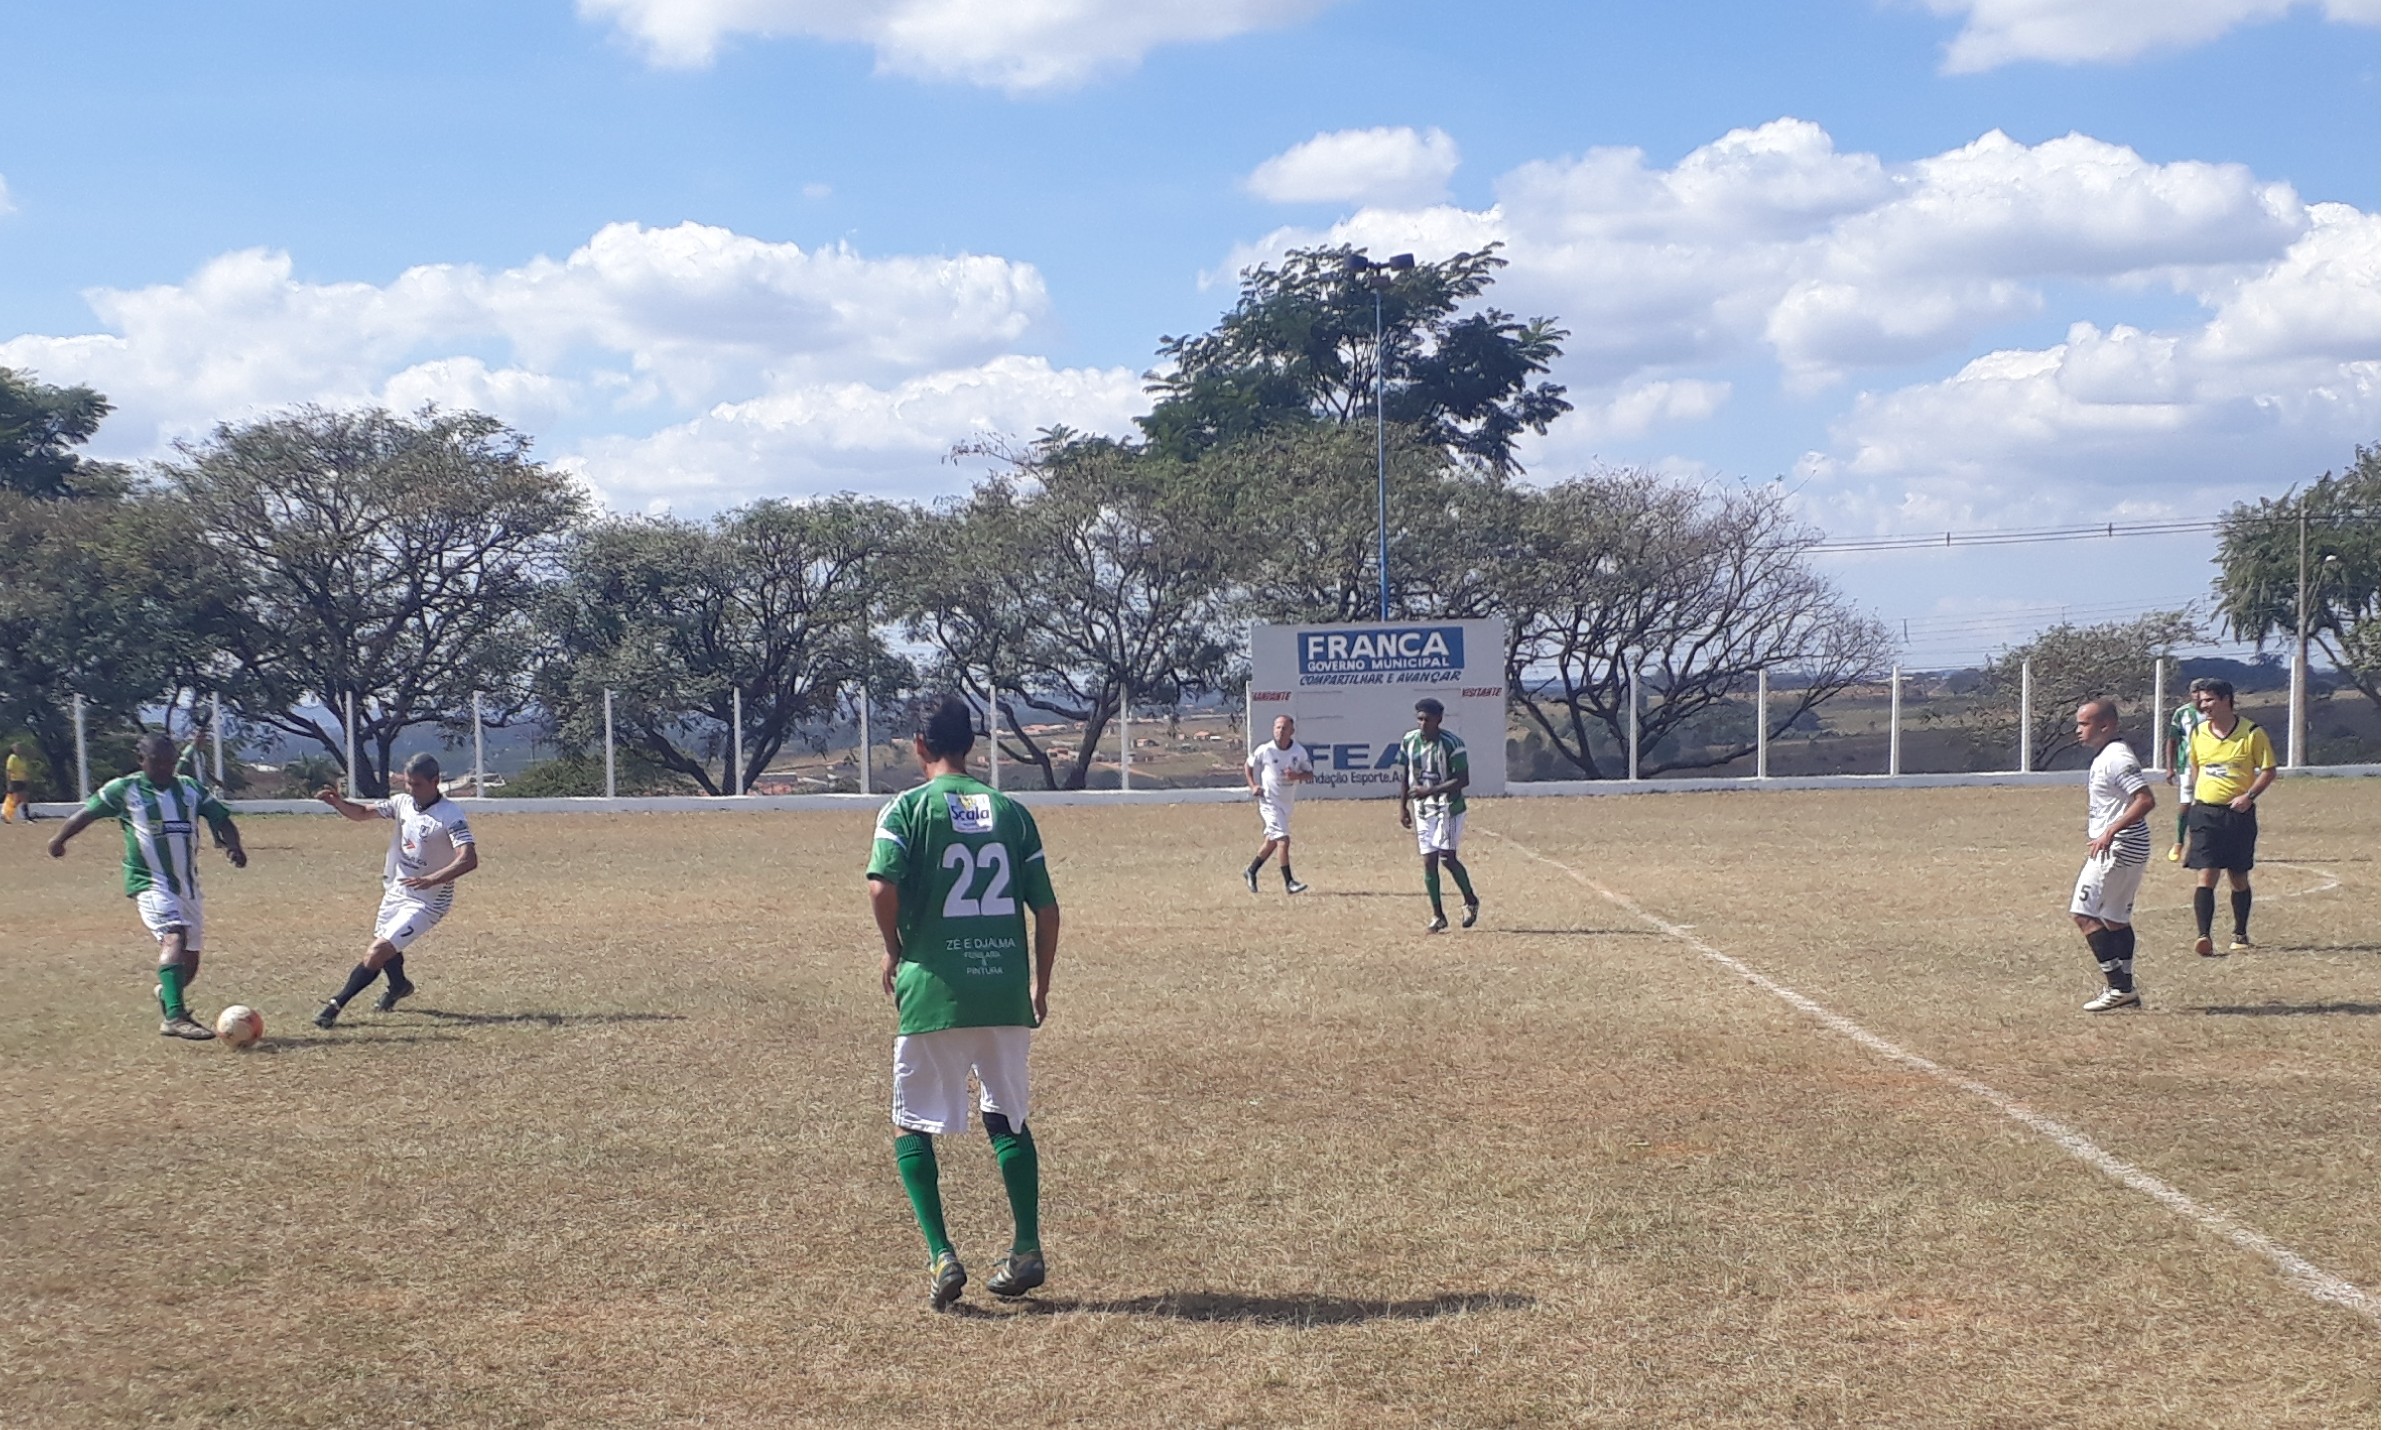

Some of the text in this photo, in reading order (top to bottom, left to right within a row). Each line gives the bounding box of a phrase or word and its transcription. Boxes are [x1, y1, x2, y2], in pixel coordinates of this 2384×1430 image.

[1307, 632, 1449, 660] FRANCA
[1307, 657, 1450, 672] GOVERNO MUNICIPAL
[1300, 671, 1462, 686] COMPARTILHAR E AVANÇAR
[1303, 743, 1401, 769] FEA
[951, 805, 990, 820] Scala
[942, 842, 1016, 918] 22
[2079, 884, 2091, 902] 5
[401, 925, 414, 937] 7
[964, 938, 972, 949] E
